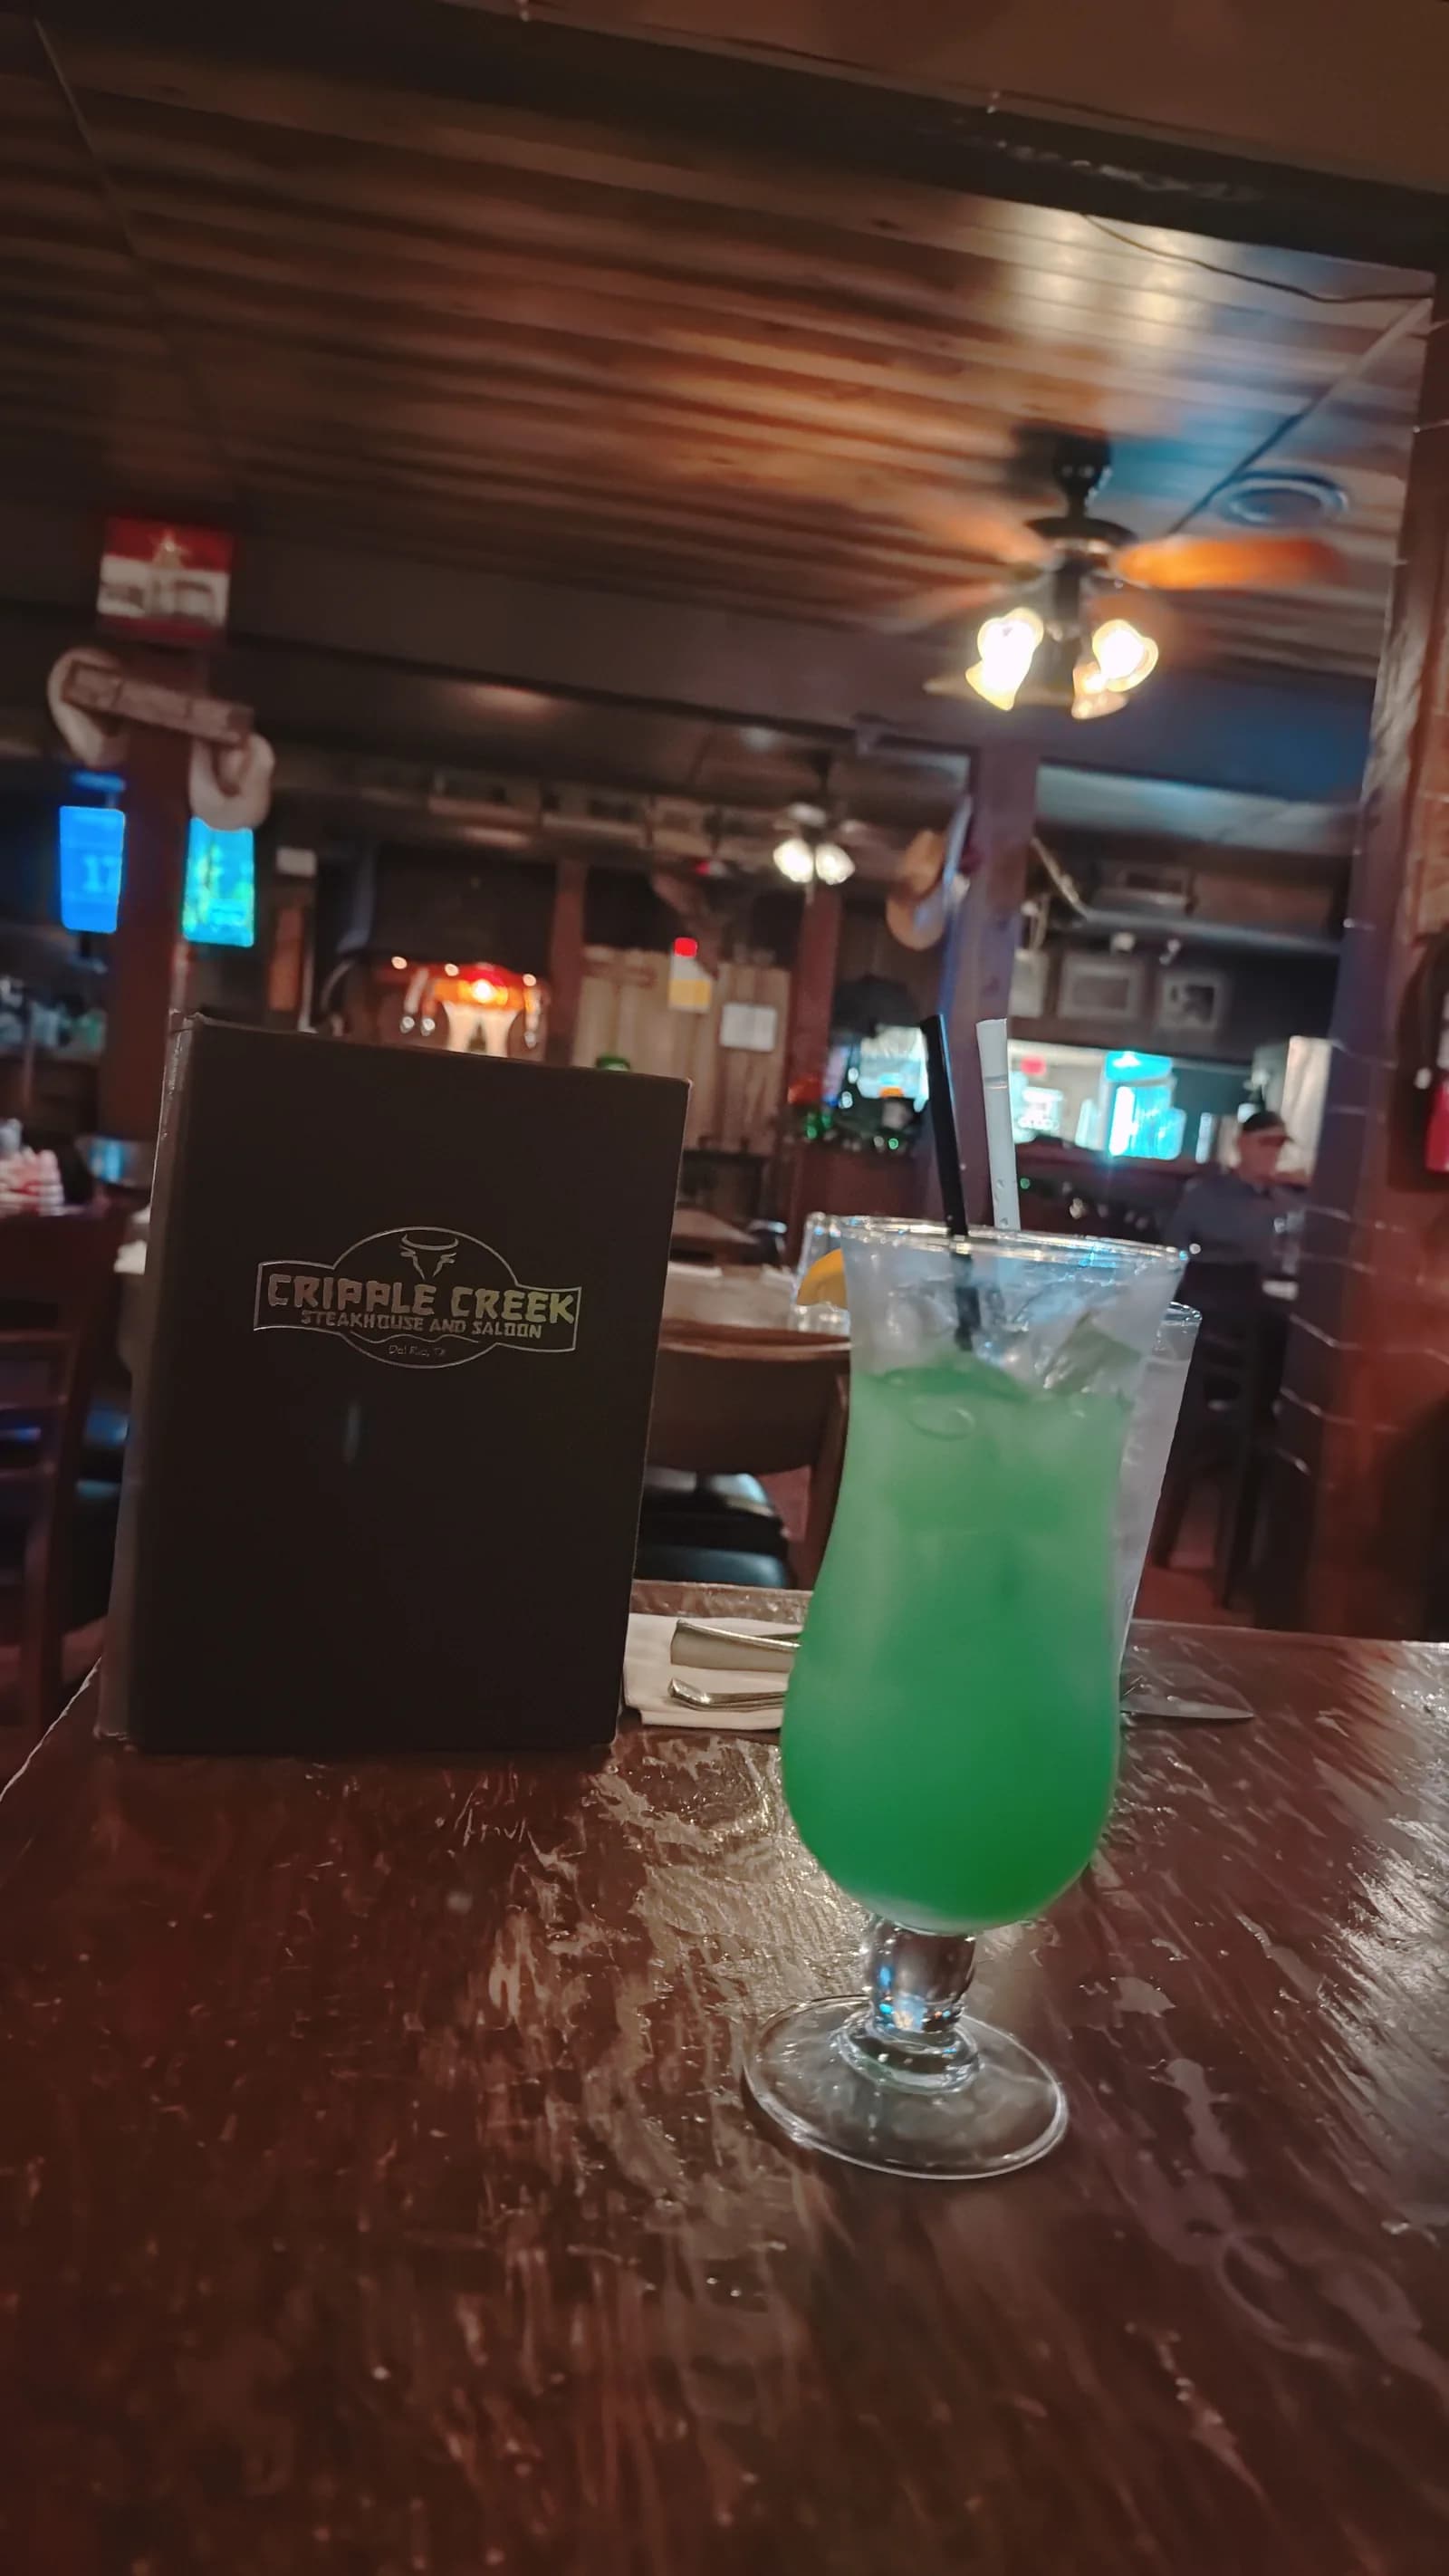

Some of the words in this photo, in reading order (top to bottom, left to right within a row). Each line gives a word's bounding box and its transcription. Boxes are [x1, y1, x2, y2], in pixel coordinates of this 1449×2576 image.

[268, 1273, 437, 1315] CRIPPLE
[451, 1285, 575, 1325] CREEK
[301, 1310, 424, 1332] STEAKHOUSE
[429, 1318, 466, 1335] AND
[472, 1322, 542, 1339] SALOON
